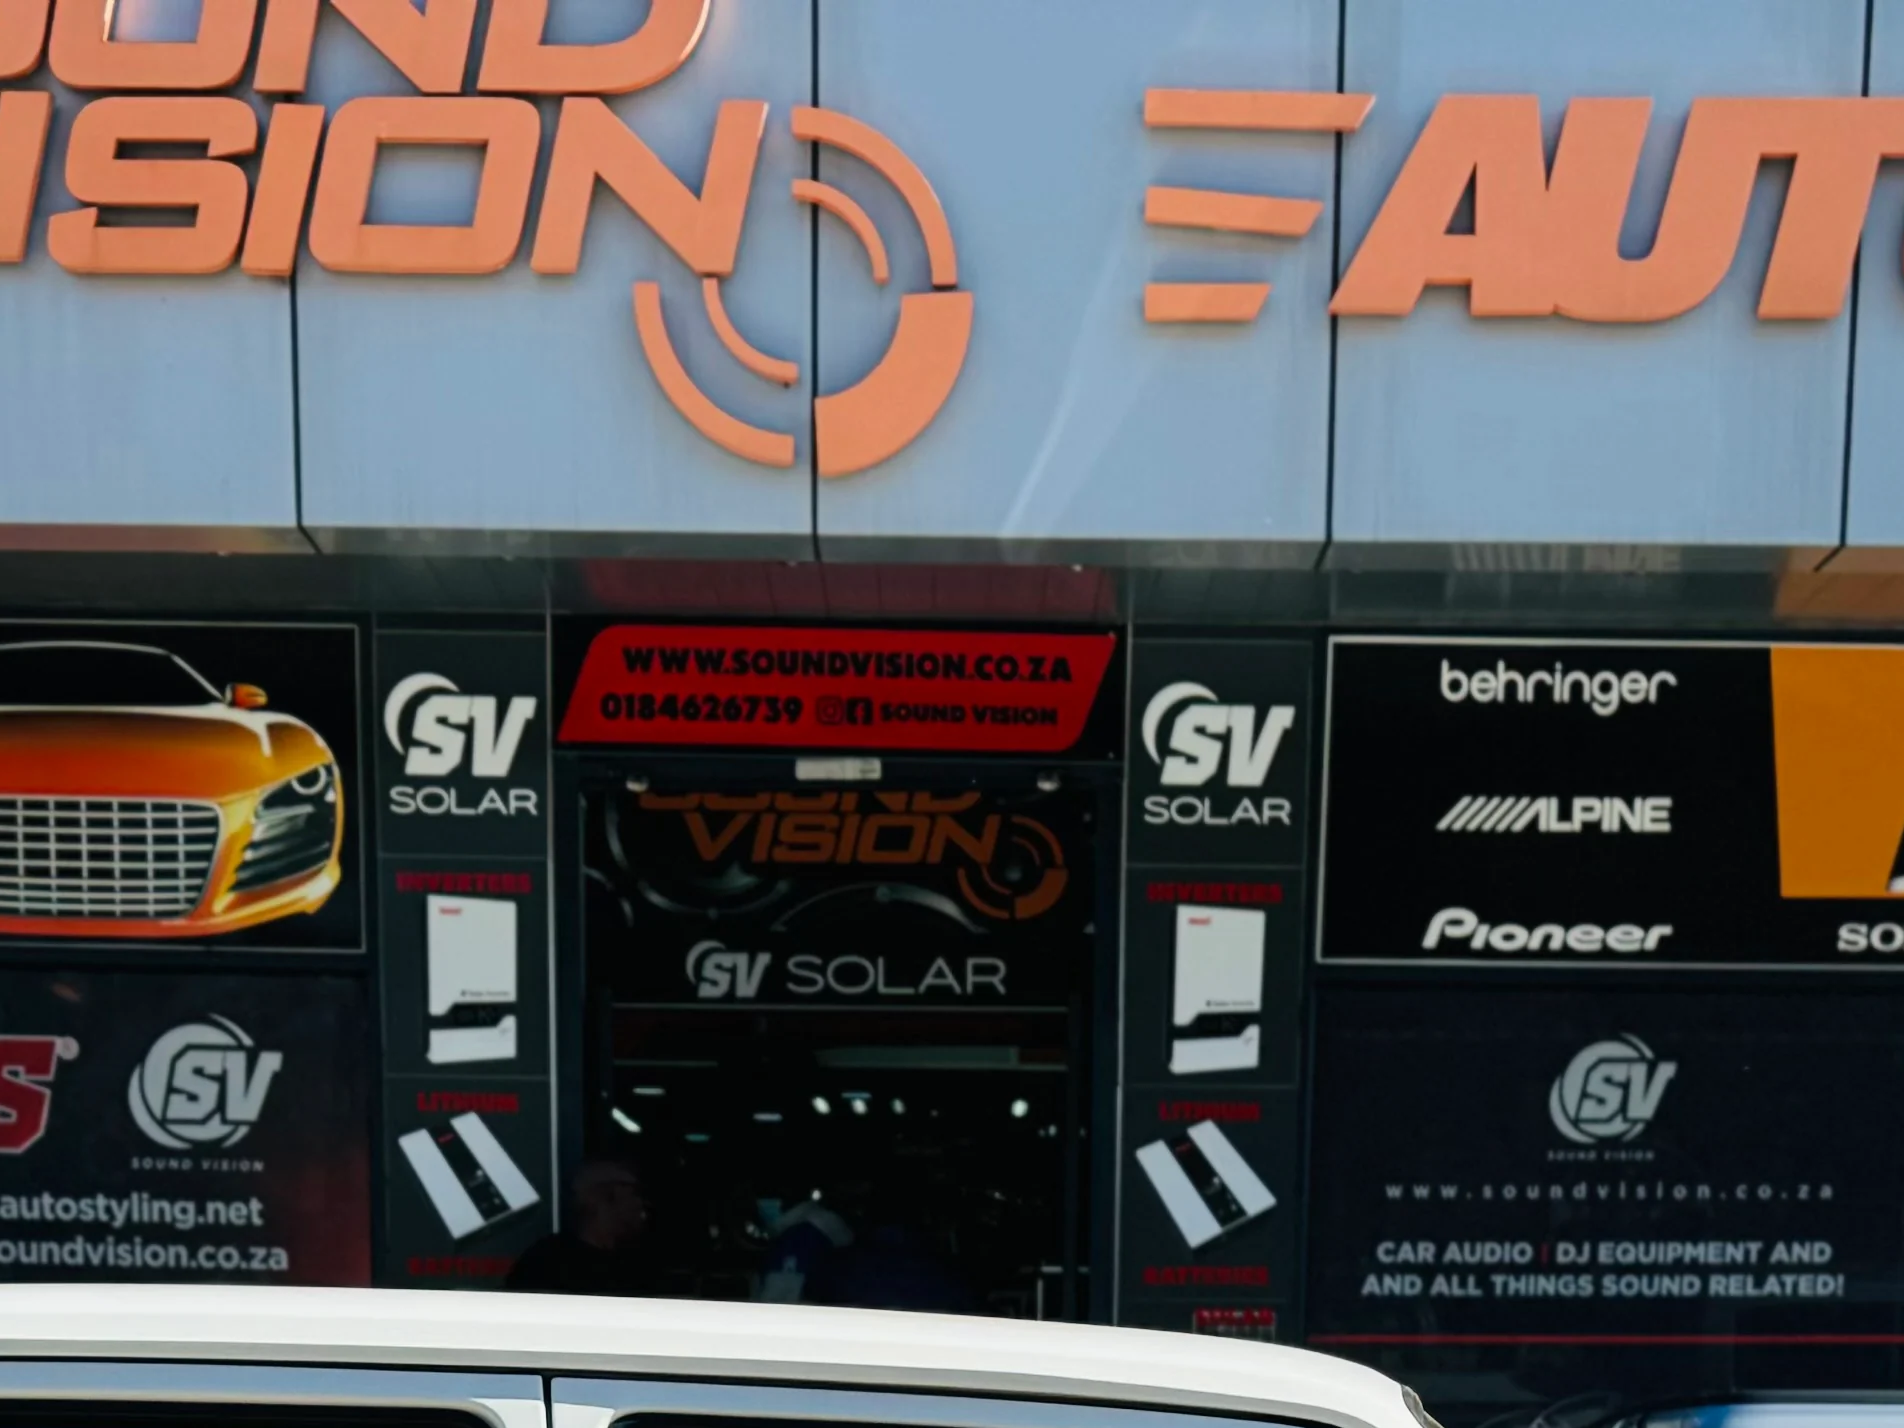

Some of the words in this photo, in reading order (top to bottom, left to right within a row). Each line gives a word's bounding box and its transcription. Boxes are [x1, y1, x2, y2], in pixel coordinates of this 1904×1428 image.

[622, 647, 1072, 683] WWW.SOUNDVISION.CO.ZA
[1441, 659, 1677, 716] behringer
[600, 693, 805, 724] 0184626739
[880, 702, 966, 724] SOUND
[972, 704, 1059, 727] VISION
[405, 694, 538, 778] SV
[1161, 705, 1295, 787] SV
[389, 786, 538, 815] SOLAR
[1143, 797, 1292, 825] SOLAR
[1511, 798, 1673, 832] ALPINE
[684, 814, 1001, 863] VISION
[1422, 908, 1673, 951] Pioneer
[697, 953, 771, 998] SV
[786, 956, 1007, 995] SOLAR
[163, 1050, 283, 1124] SV
[1577, 1061, 1677, 1122] SV
[130, 1156, 194, 1171] SOUND
[200, 1157, 266, 1173] VISION
[1385, 1180, 1834, 1200] www.soundvision.co.za
[1377, 1242, 1436, 1264] CAR
[1443, 1242, 1534, 1264] AUDIO
[1556, 1242, 1591, 1267] DJ
[1598, 1242, 1763, 1264] EQUIPMENT
[1769, 1242, 1832, 1264] AND
[1362, 1275, 1423, 1296] AND
[1430, 1275, 1483, 1296] ALL
[1491, 1275, 1593, 1297] THINGS
[1601, 1275, 1702, 1297] SOUND
[1708, 1275, 1844, 1297] RELATED!
